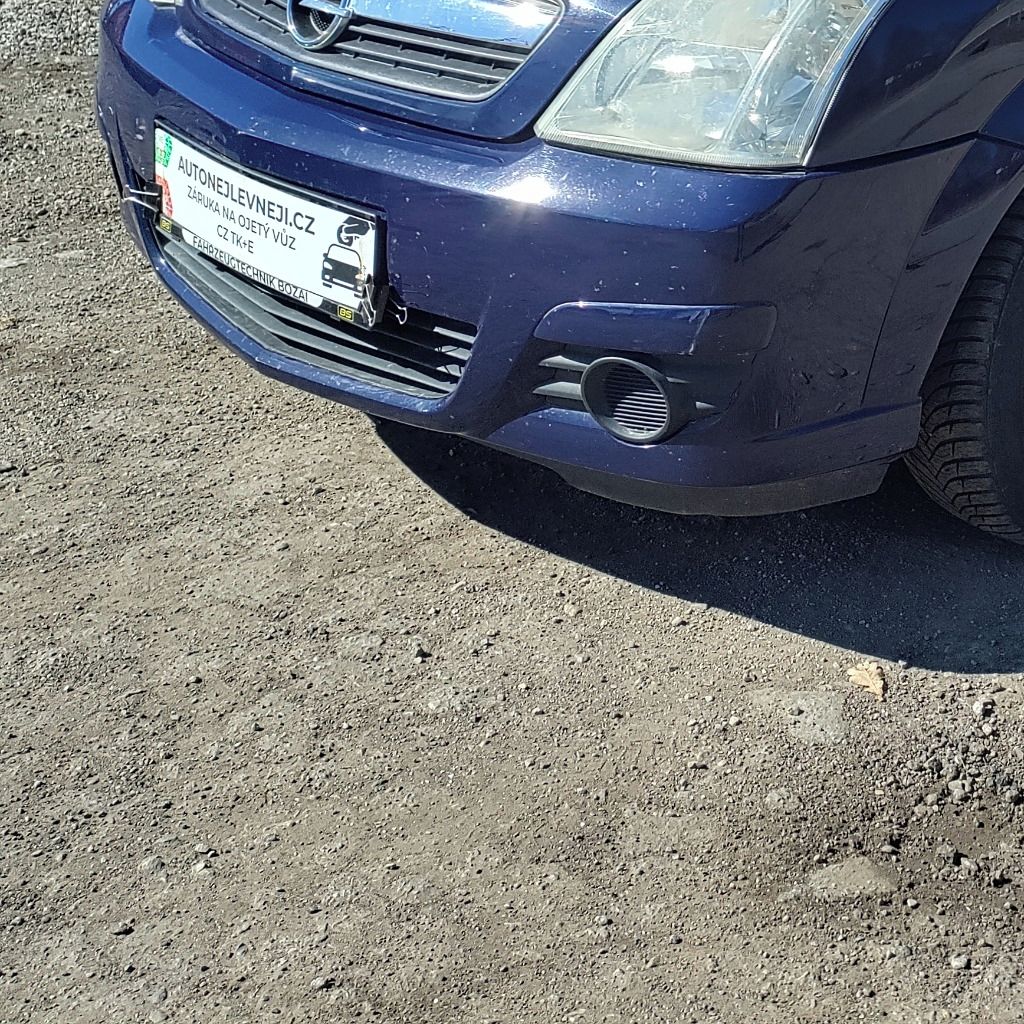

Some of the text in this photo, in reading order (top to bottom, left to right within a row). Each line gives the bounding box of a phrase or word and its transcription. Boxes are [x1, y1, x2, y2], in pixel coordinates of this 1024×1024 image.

[178, 155, 316, 236] AUTONEJLEVNEJI.CZ
[187, 185, 221, 216] ZÁRUKA
[222, 205, 236, 224] NA
[238, 214, 270, 239] OJETÝ
[272, 228, 296, 251] VŮZ
[192, 235, 277, 290] FAHRZEUGTECHNIK
[216, 224, 254, 254] CZ TK+E
